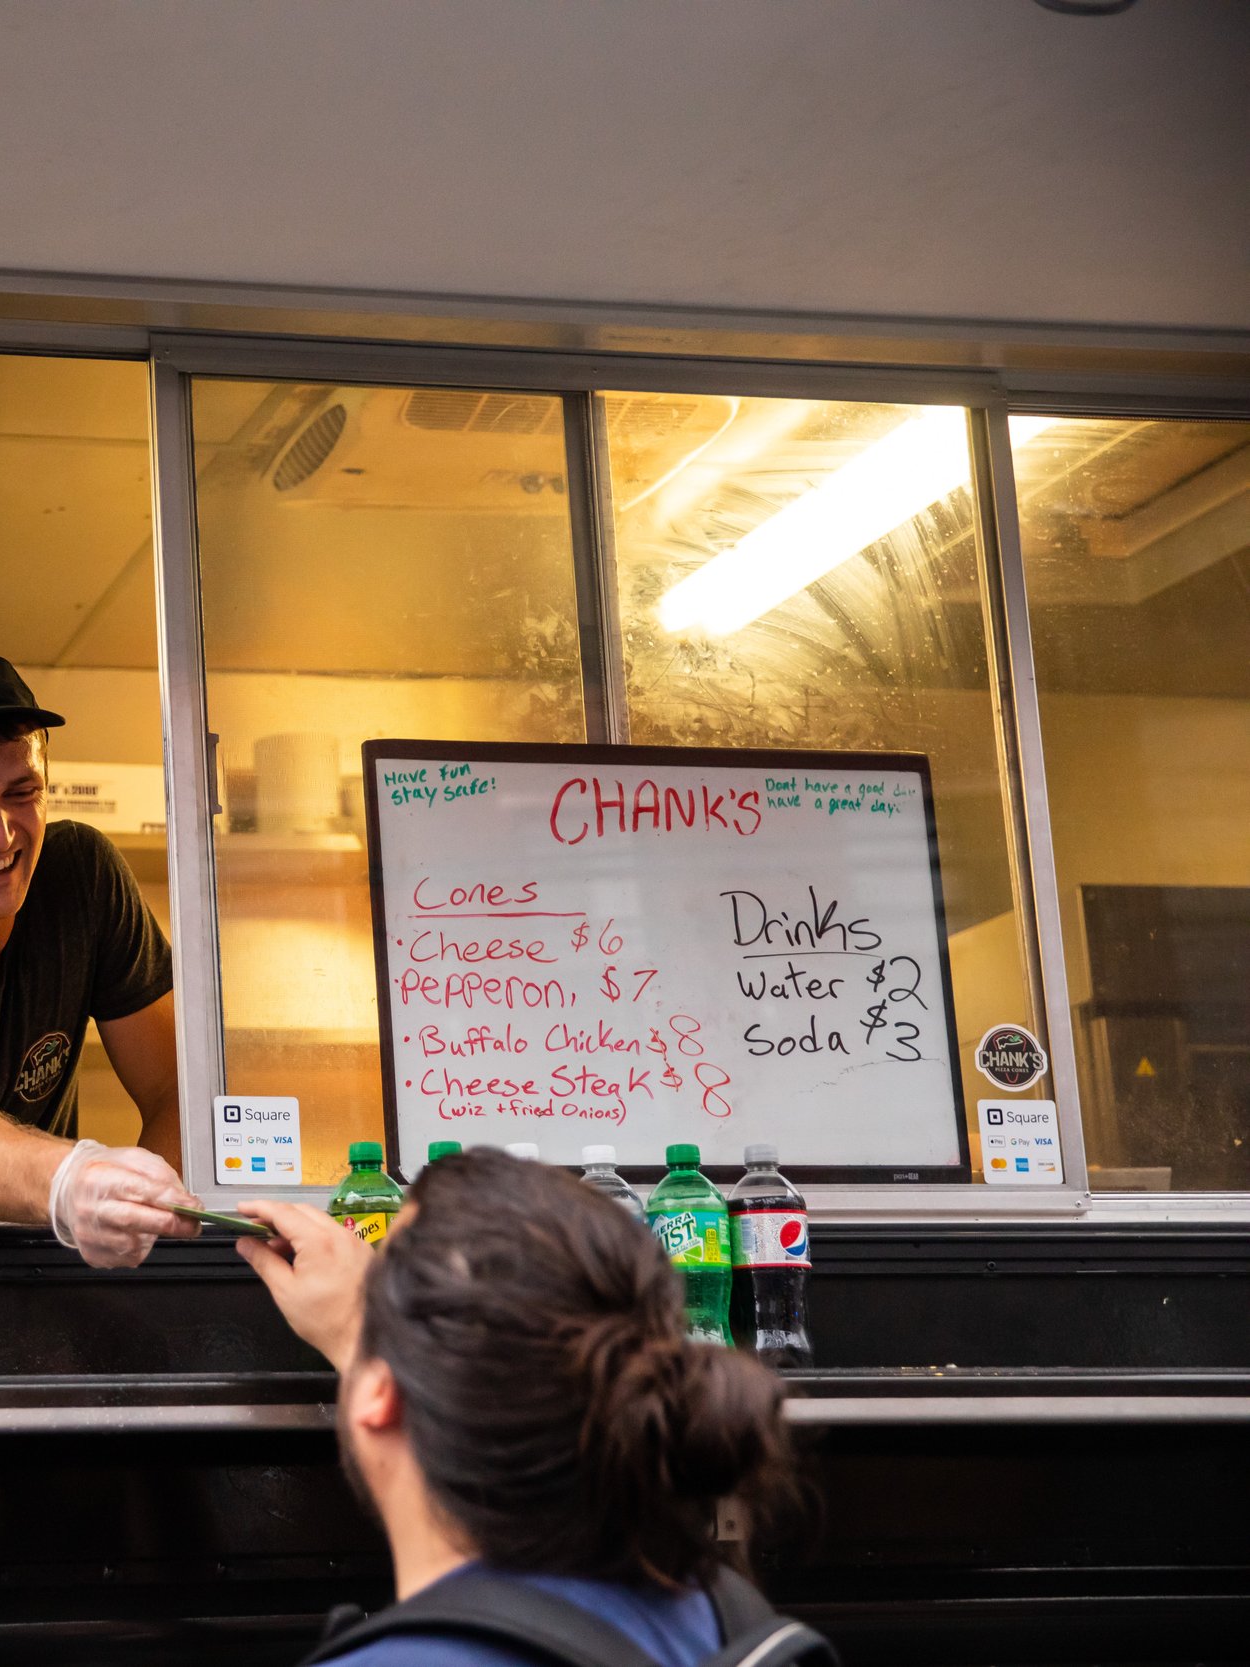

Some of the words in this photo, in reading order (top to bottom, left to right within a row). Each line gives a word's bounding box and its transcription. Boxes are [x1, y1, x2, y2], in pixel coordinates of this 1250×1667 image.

[384, 768, 427, 786] Have
[391, 786, 438, 808] stay
[443, 777, 496, 801] safe!
[765, 776, 797, 792] Dont
[805, 777, 839, 793] have
[845, 784, 852, 795] a
[859, 781, 885, 799] good
[550, 777, 761, 845] CHANK'S
[767, 795, 801, 809] have
[814, 800, 823, 810] a
[829, 798, 862, 816] great
[413, 876, 538, 910] Cones
[720, 885, 882, 951] Drinks
[410, 930, 559, 963] Cheese
[866, 956, 928, 1010] $2
[419, 1025, 528, 1058] Buffalo
[545, 1020, 640, 1053] Chicken
[744, 1014, 850, 1056] Soda
[859, 998, 922, 1062] $3
[979, 1050, 1044, 1070] CHANK'S
[420, 1068, 540, 1097] Cheese
[550, 1065, 654, 1100] Steak
[244, 1108, 291, 1124] Square
[1006, 1111, 1049, 1126] Square
[256, 1136, 268, 1146] Pay
[273, 1136, 293, 1144] VISA
[1018, 1138, 1030, 1147] Pay
[664, 1219, 695, 1252] IST
